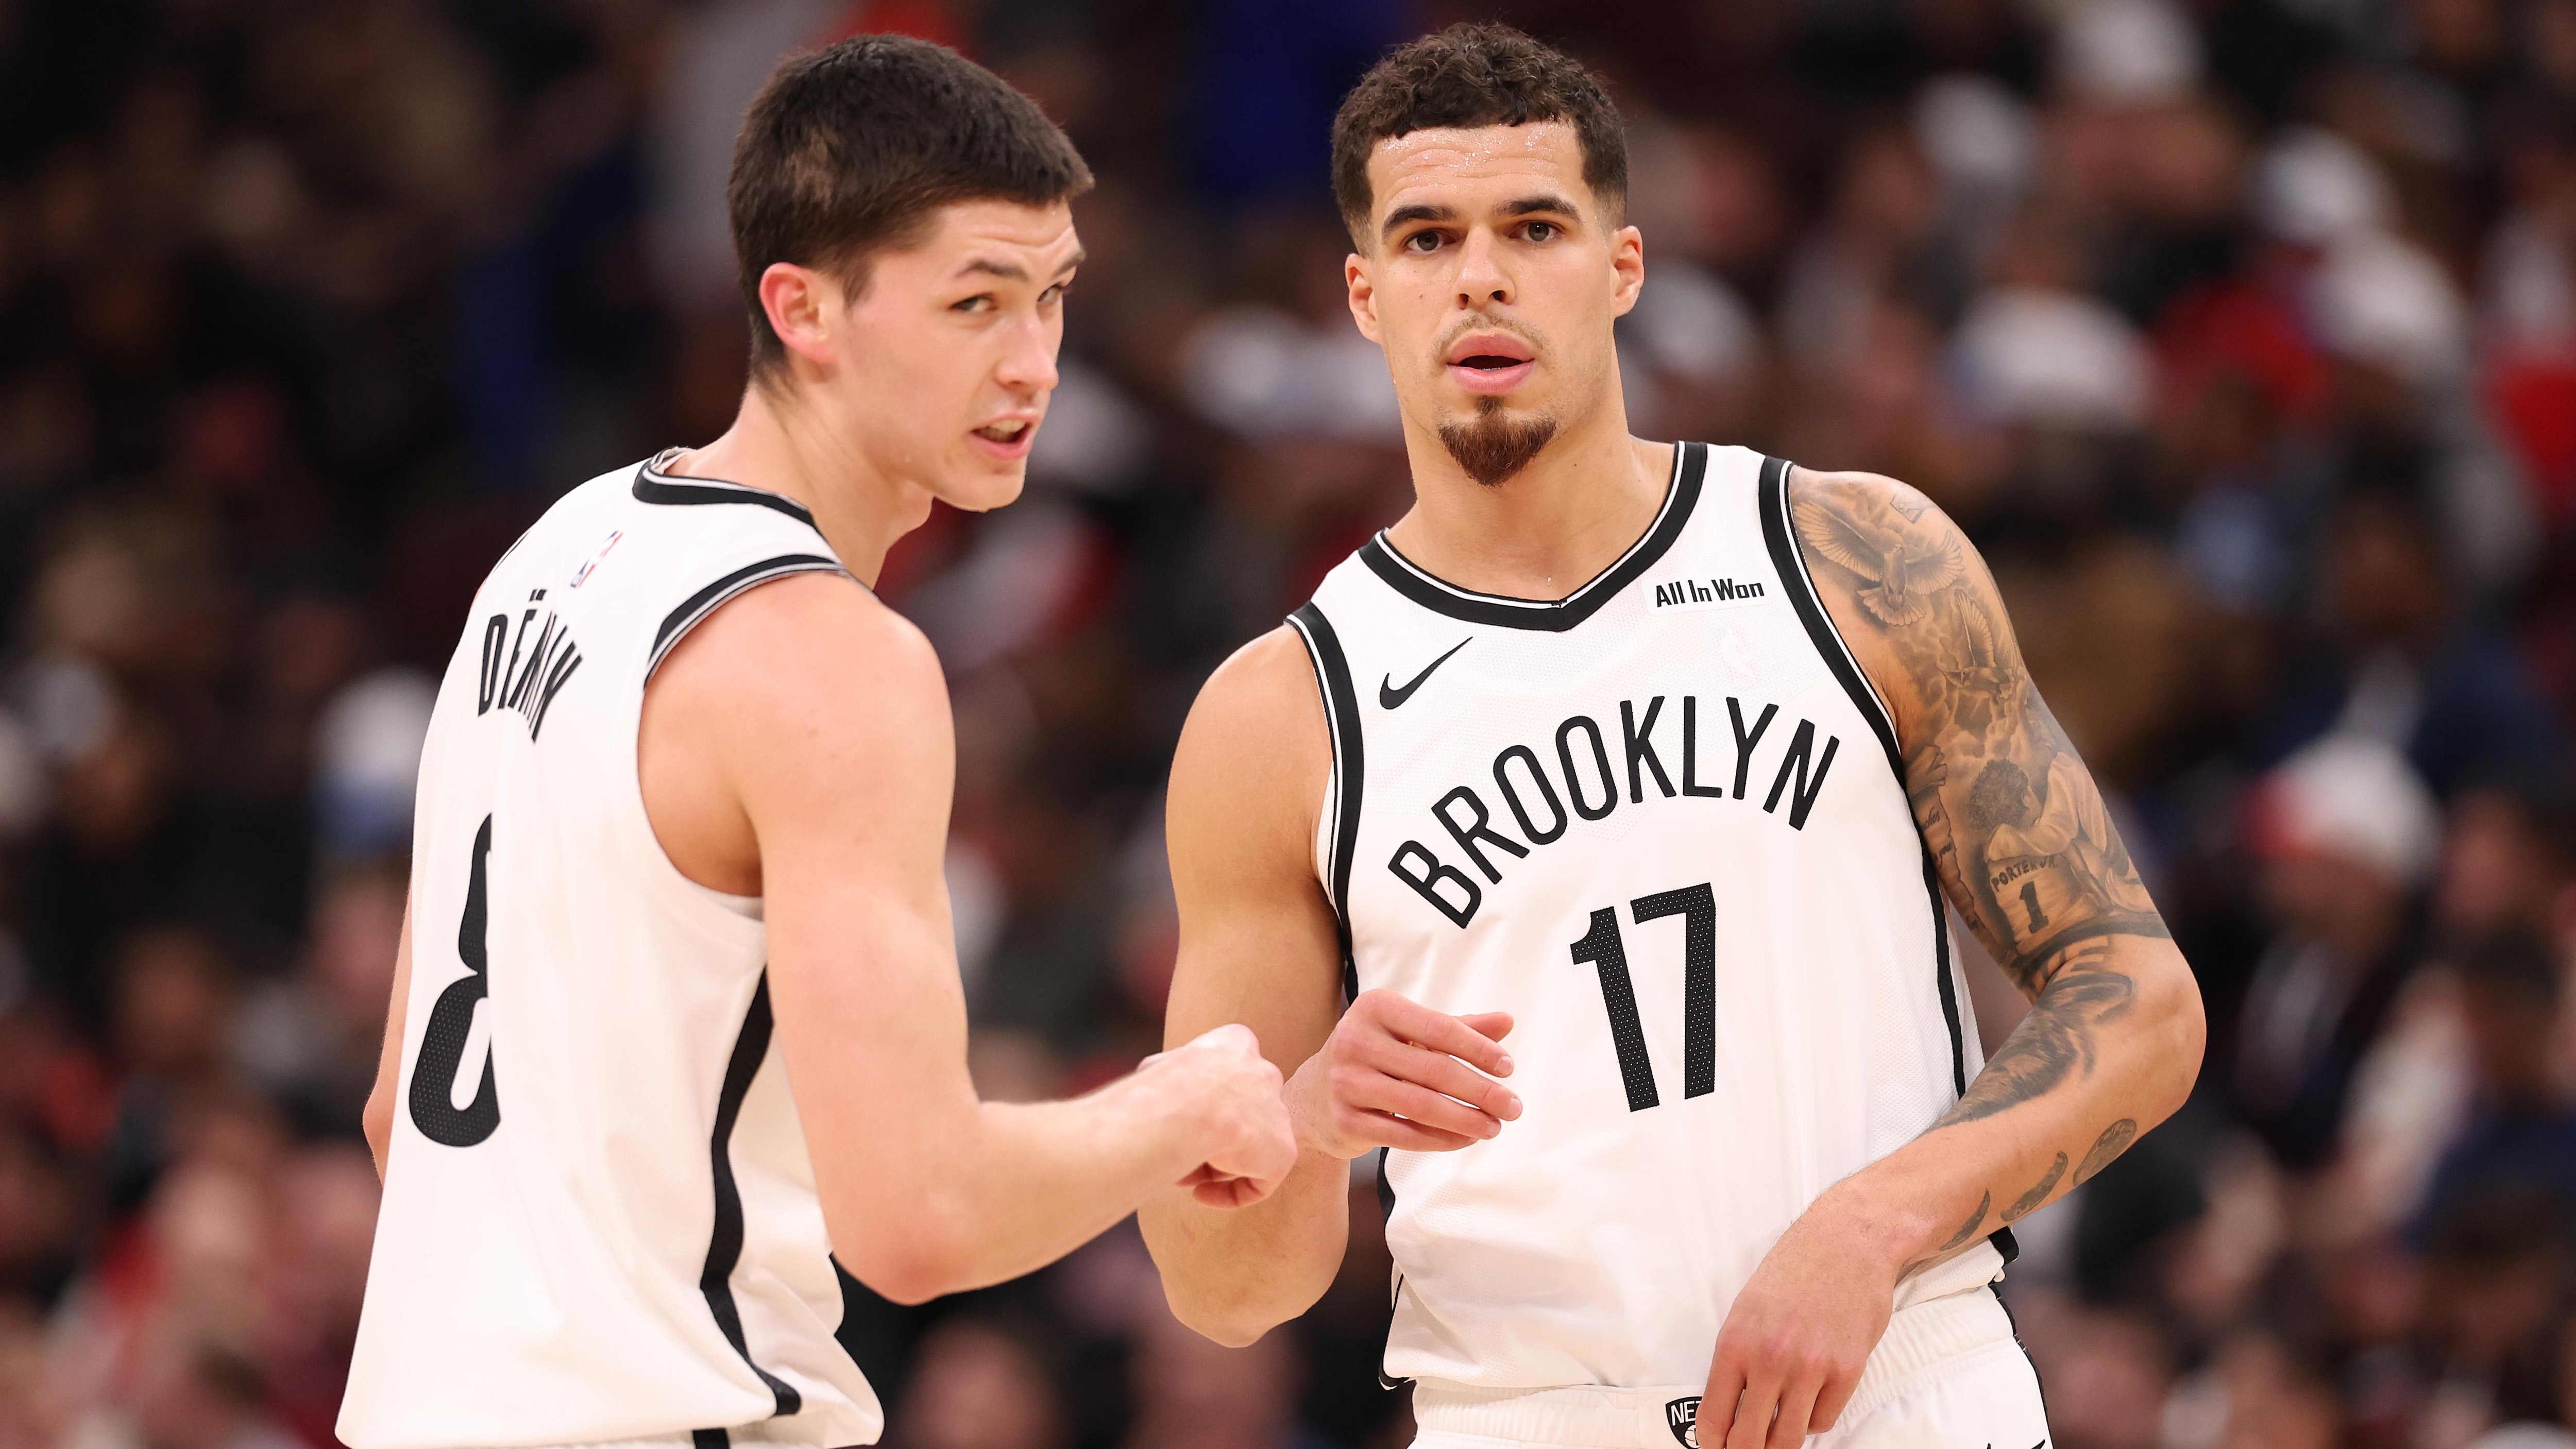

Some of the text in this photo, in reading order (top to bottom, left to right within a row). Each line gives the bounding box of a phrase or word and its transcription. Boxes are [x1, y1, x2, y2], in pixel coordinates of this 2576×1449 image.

[1656, 578, 1765, 608] All In Won
[1387, 695, 1840, 929] BROOKLYN
[1991, 859, 2038, 892] PORTER
[2019, 881, 2049, 934] 1
[1570, 882, 1716, 1113] 17
[1671, 1400, 1702, 1426] NE
